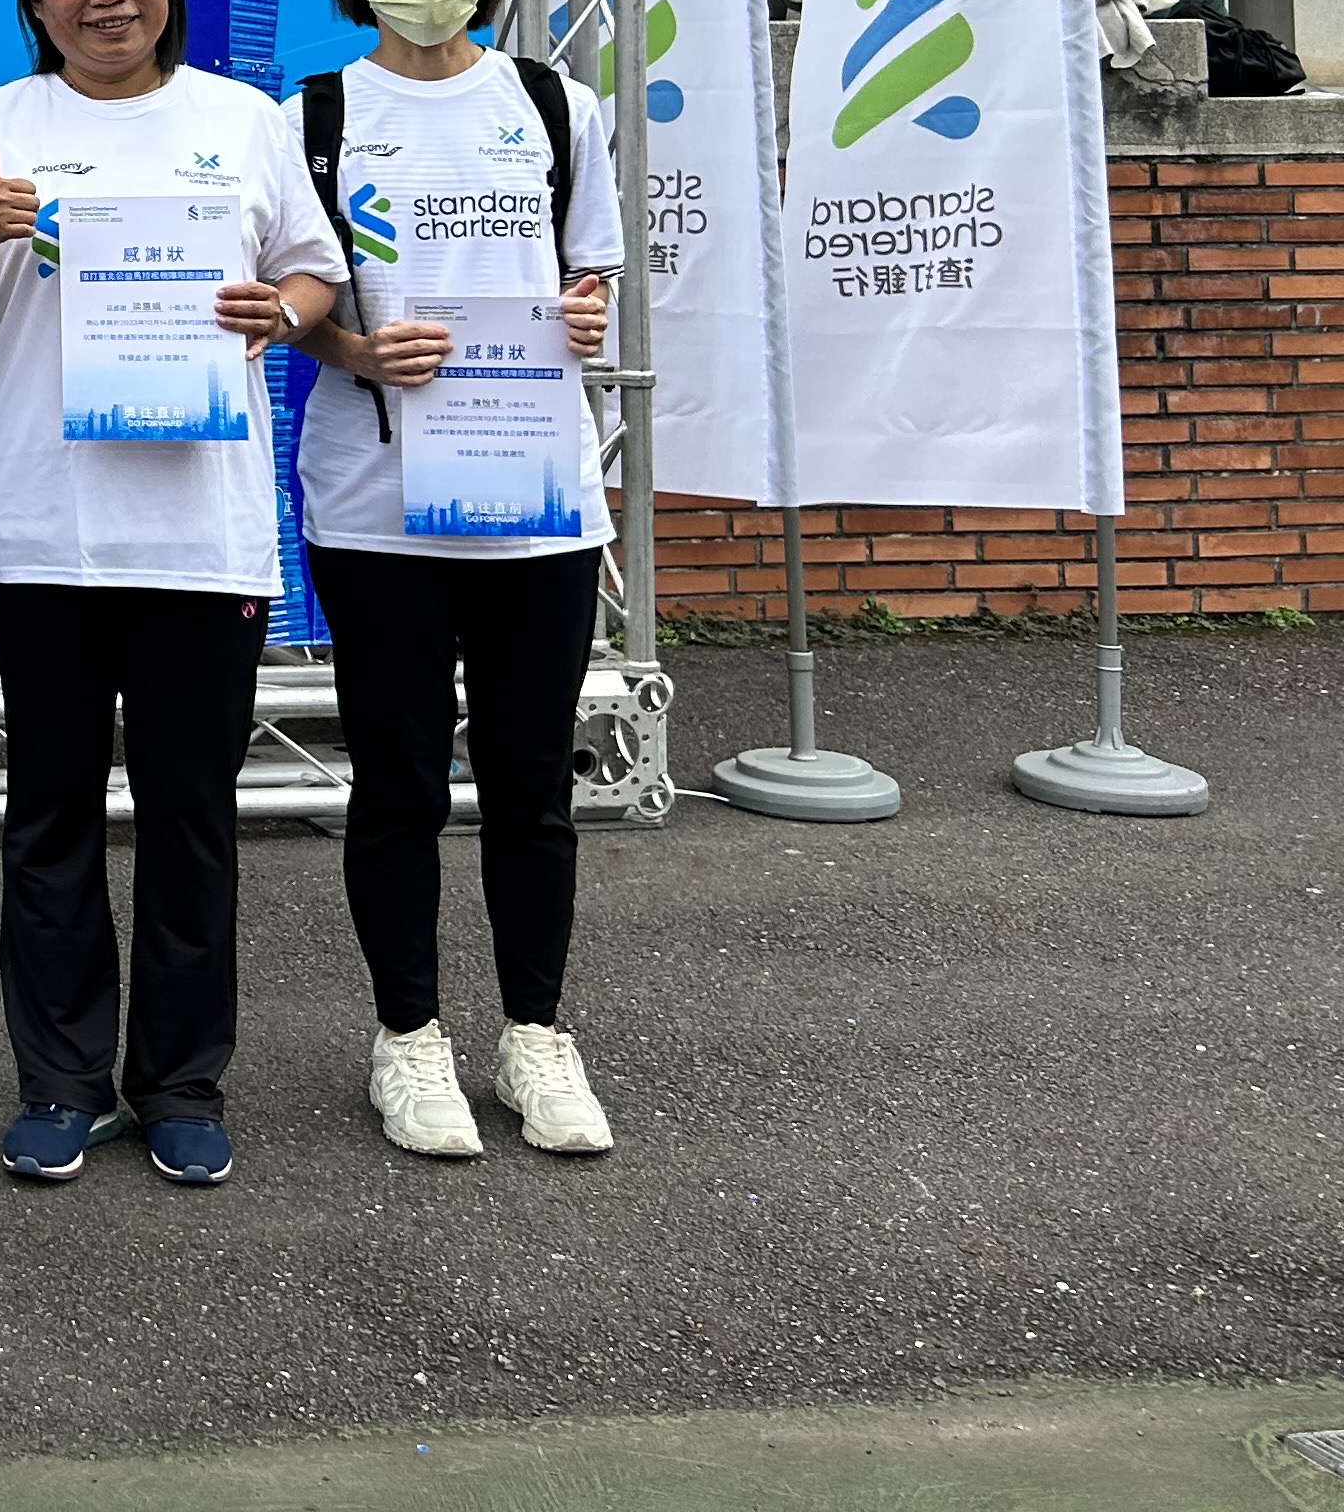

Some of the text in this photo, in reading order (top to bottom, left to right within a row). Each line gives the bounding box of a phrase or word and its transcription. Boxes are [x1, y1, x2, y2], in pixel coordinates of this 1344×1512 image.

[32, 162, 82, 174] saucony
[414, 190, 541, 216] standard
[416, 215, 541, 240] chartered
[123, 246, 185, 262] 感謝狀
[465, 344, 525, 361] 感謝狀
